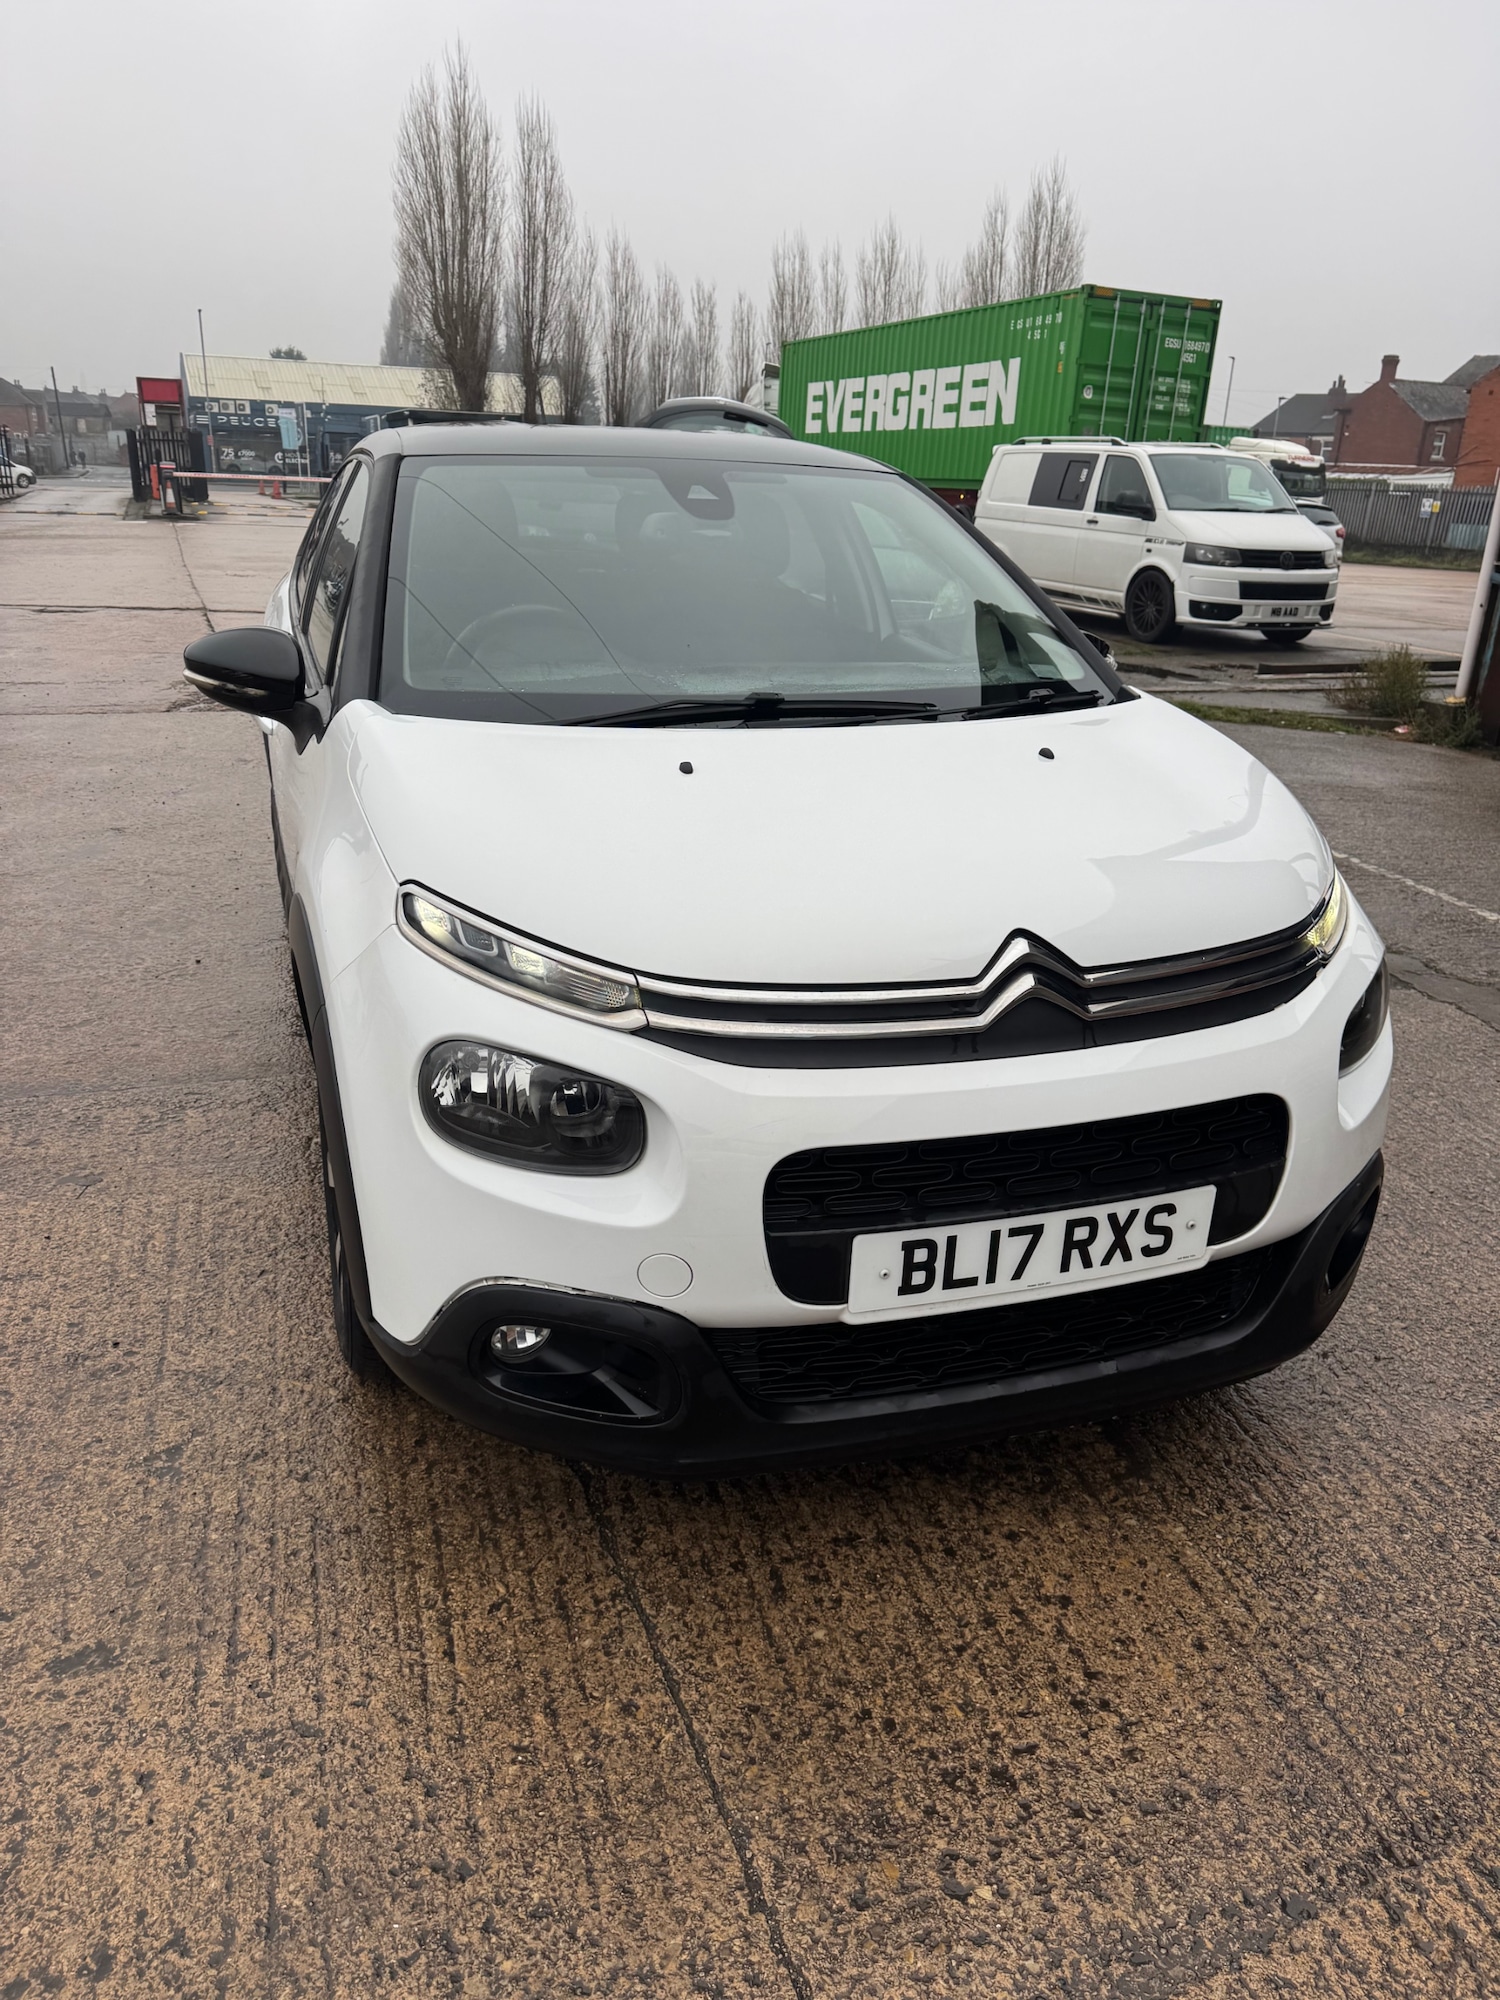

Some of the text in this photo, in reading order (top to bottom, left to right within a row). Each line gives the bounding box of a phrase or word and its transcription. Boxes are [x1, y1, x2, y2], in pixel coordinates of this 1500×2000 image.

[1164, 337, 1181, 349] EGSU
[805, 357, 1021, 434] EVERGREEN
[217, 415, 281, 427] PEUGE
[897, 1203, 1177, 1297] BL17 RXS
